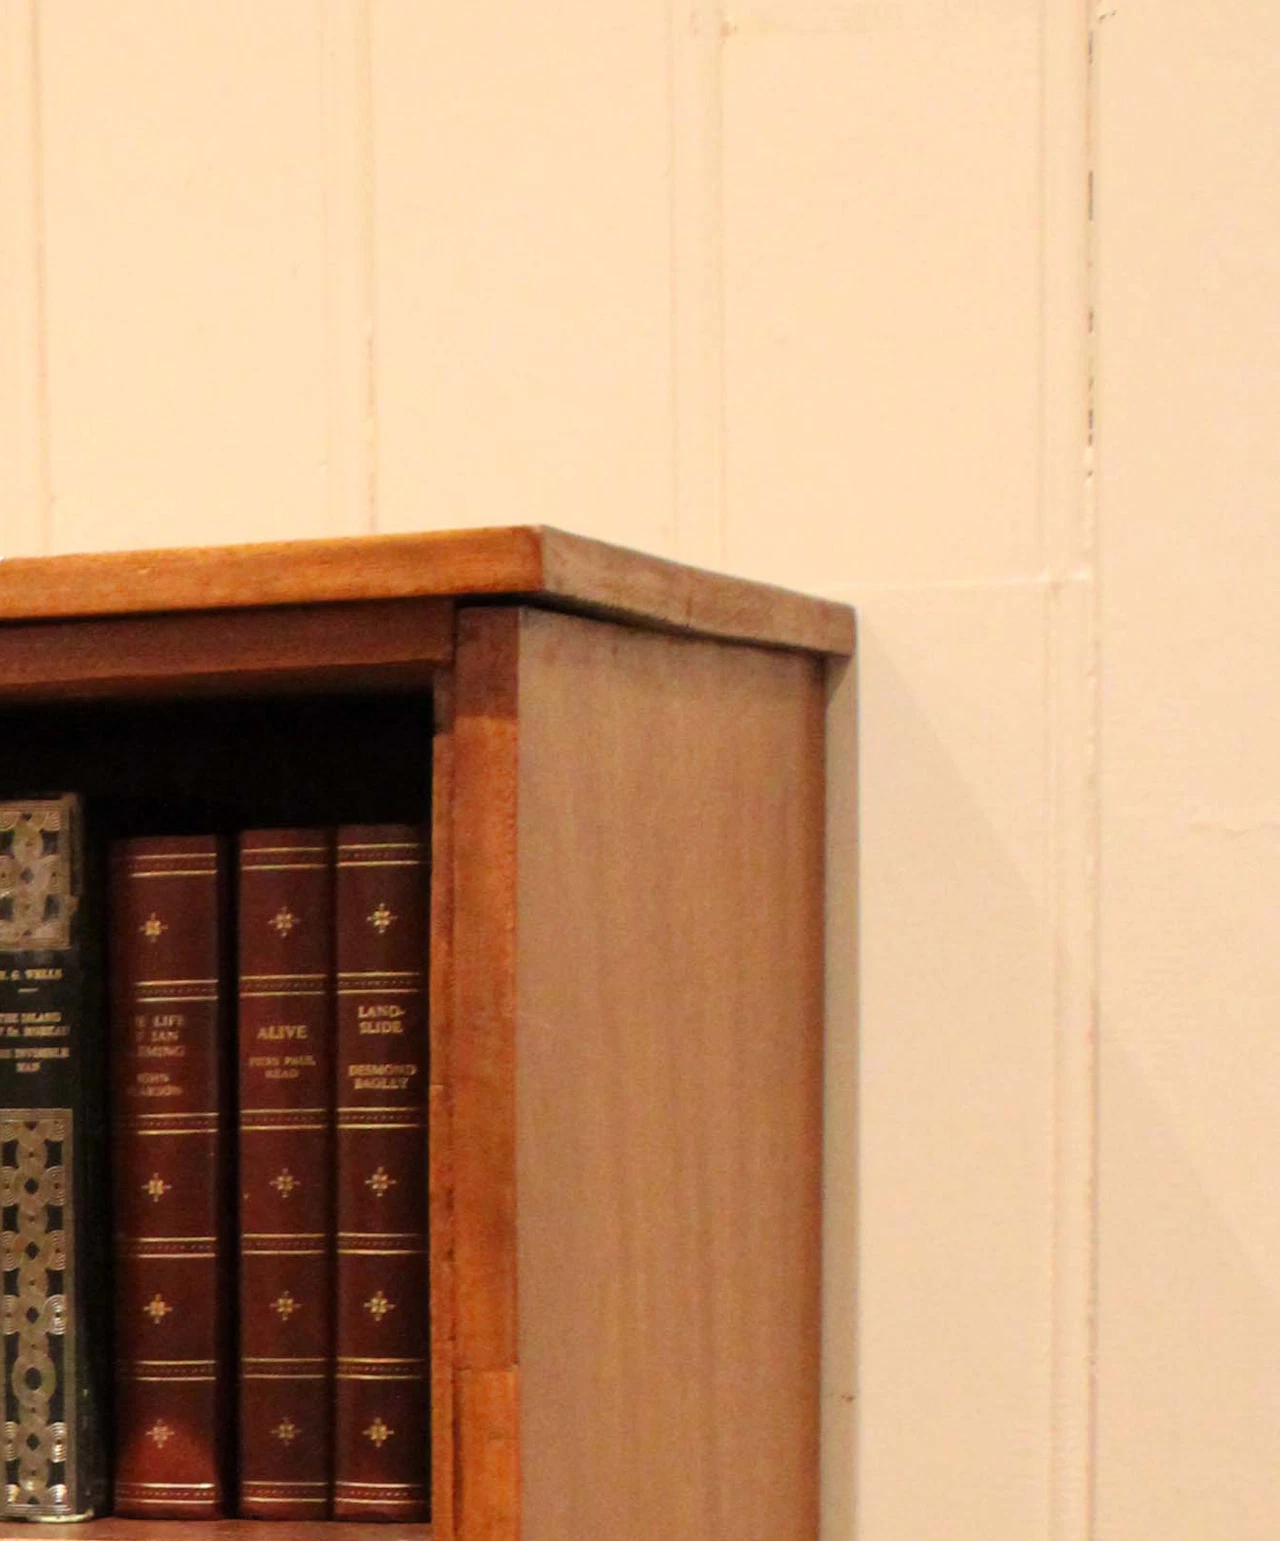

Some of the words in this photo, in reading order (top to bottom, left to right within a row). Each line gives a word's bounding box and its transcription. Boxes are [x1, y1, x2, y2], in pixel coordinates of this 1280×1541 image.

[357, 1005, 406, 1018] LAND-
[257, 1025, 308, 1040] ALIVE
[359, 1020, 403, 1034] SLIDE
[348, 1063, 417, 1077] DESMOND
